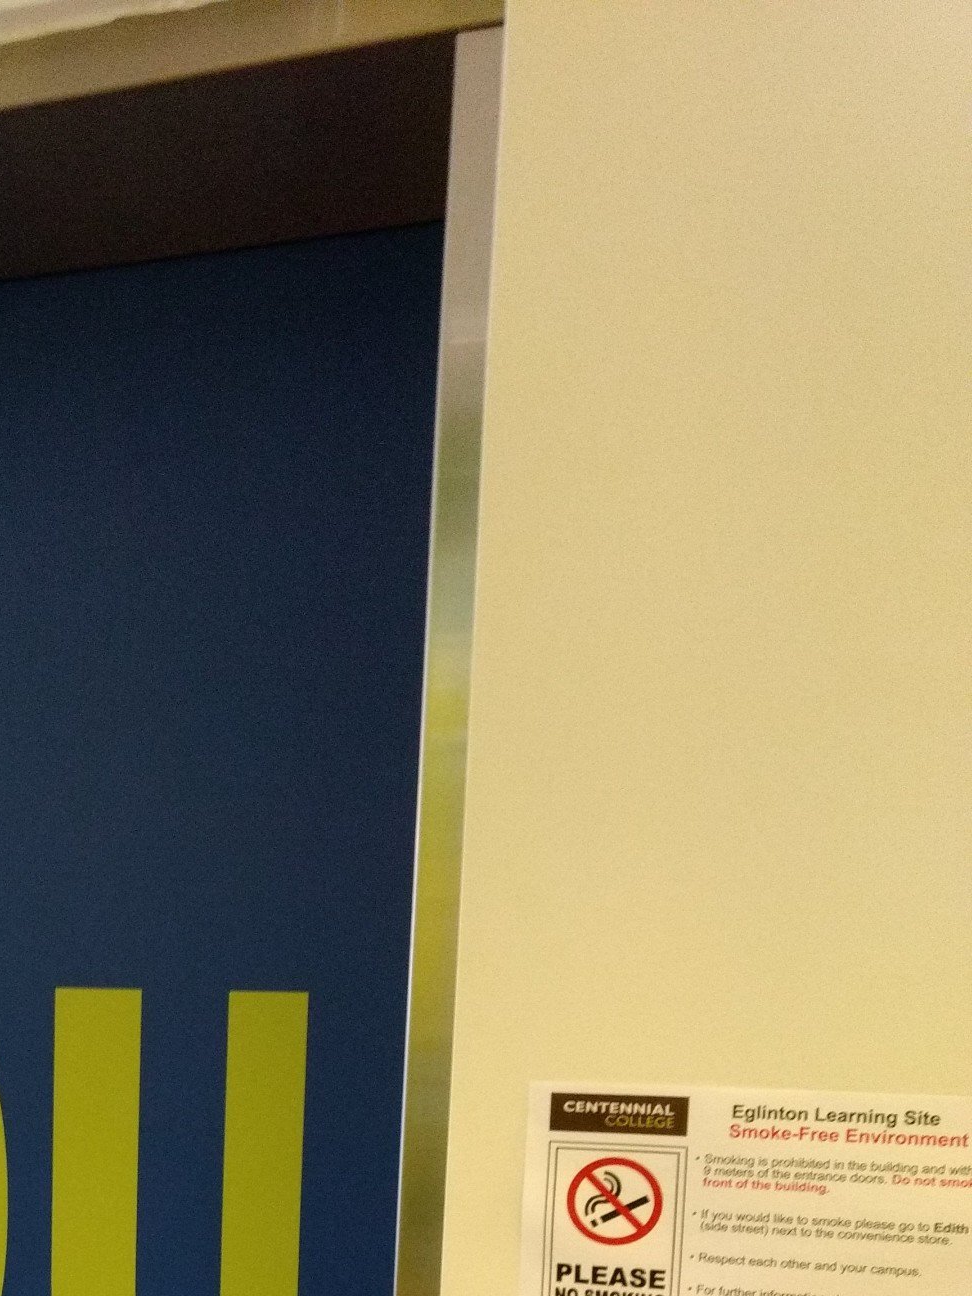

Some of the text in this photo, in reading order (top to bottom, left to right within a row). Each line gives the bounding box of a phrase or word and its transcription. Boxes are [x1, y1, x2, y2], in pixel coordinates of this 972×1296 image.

[563, 1100, 675, 1116] CENTENNIAL
[732, 1104, 941, 1128] Eglinton Learning Site
[604, 1115, 675, 1129] COLLEGE
[730, 1124, 969, 1147] Smoke-Free Environment
[704, 1153, 755, 1168] Smoking
[758, 1156, 768, 1166] is
[771, 1157, 830, 1170] prohibited
[834, 1160, 845, 1170] in
[847, 1160, 867, 1171] the
[870, 1160, 919, 1176] building
[921, 1164, 946, 1175] and
[703, 1177, 829, 1195] front of the building.
[714, 1167, 754, 1178] meters
[757, 1168, 769, 1178] of
[771, 1168, 791, 1179] the
[794, 1171, 847, 1182] entrance
[849, 1173, 887, 1184] doors.
[892, 1174, 910, 1185] Do
[914, 1177, 935, 1187] not
[700, 1208, 969, 1234] If you would like to smoke please go to Edith
[700, 1221, 728, 1232] (side
[731, 1223, 768, 1237] street)
[771, 1227, 797, 1236] next
[800, 1227, 812, 1237] to
[815, 1228, 835, 1238] the
[837, 1230, 915, 1243] convenience
[556, 1262, 667, 1289] PLEASE
[698, 1252, 922, 1278] Respect each other and your campus.
[695, 1284, 716, 1295] For
